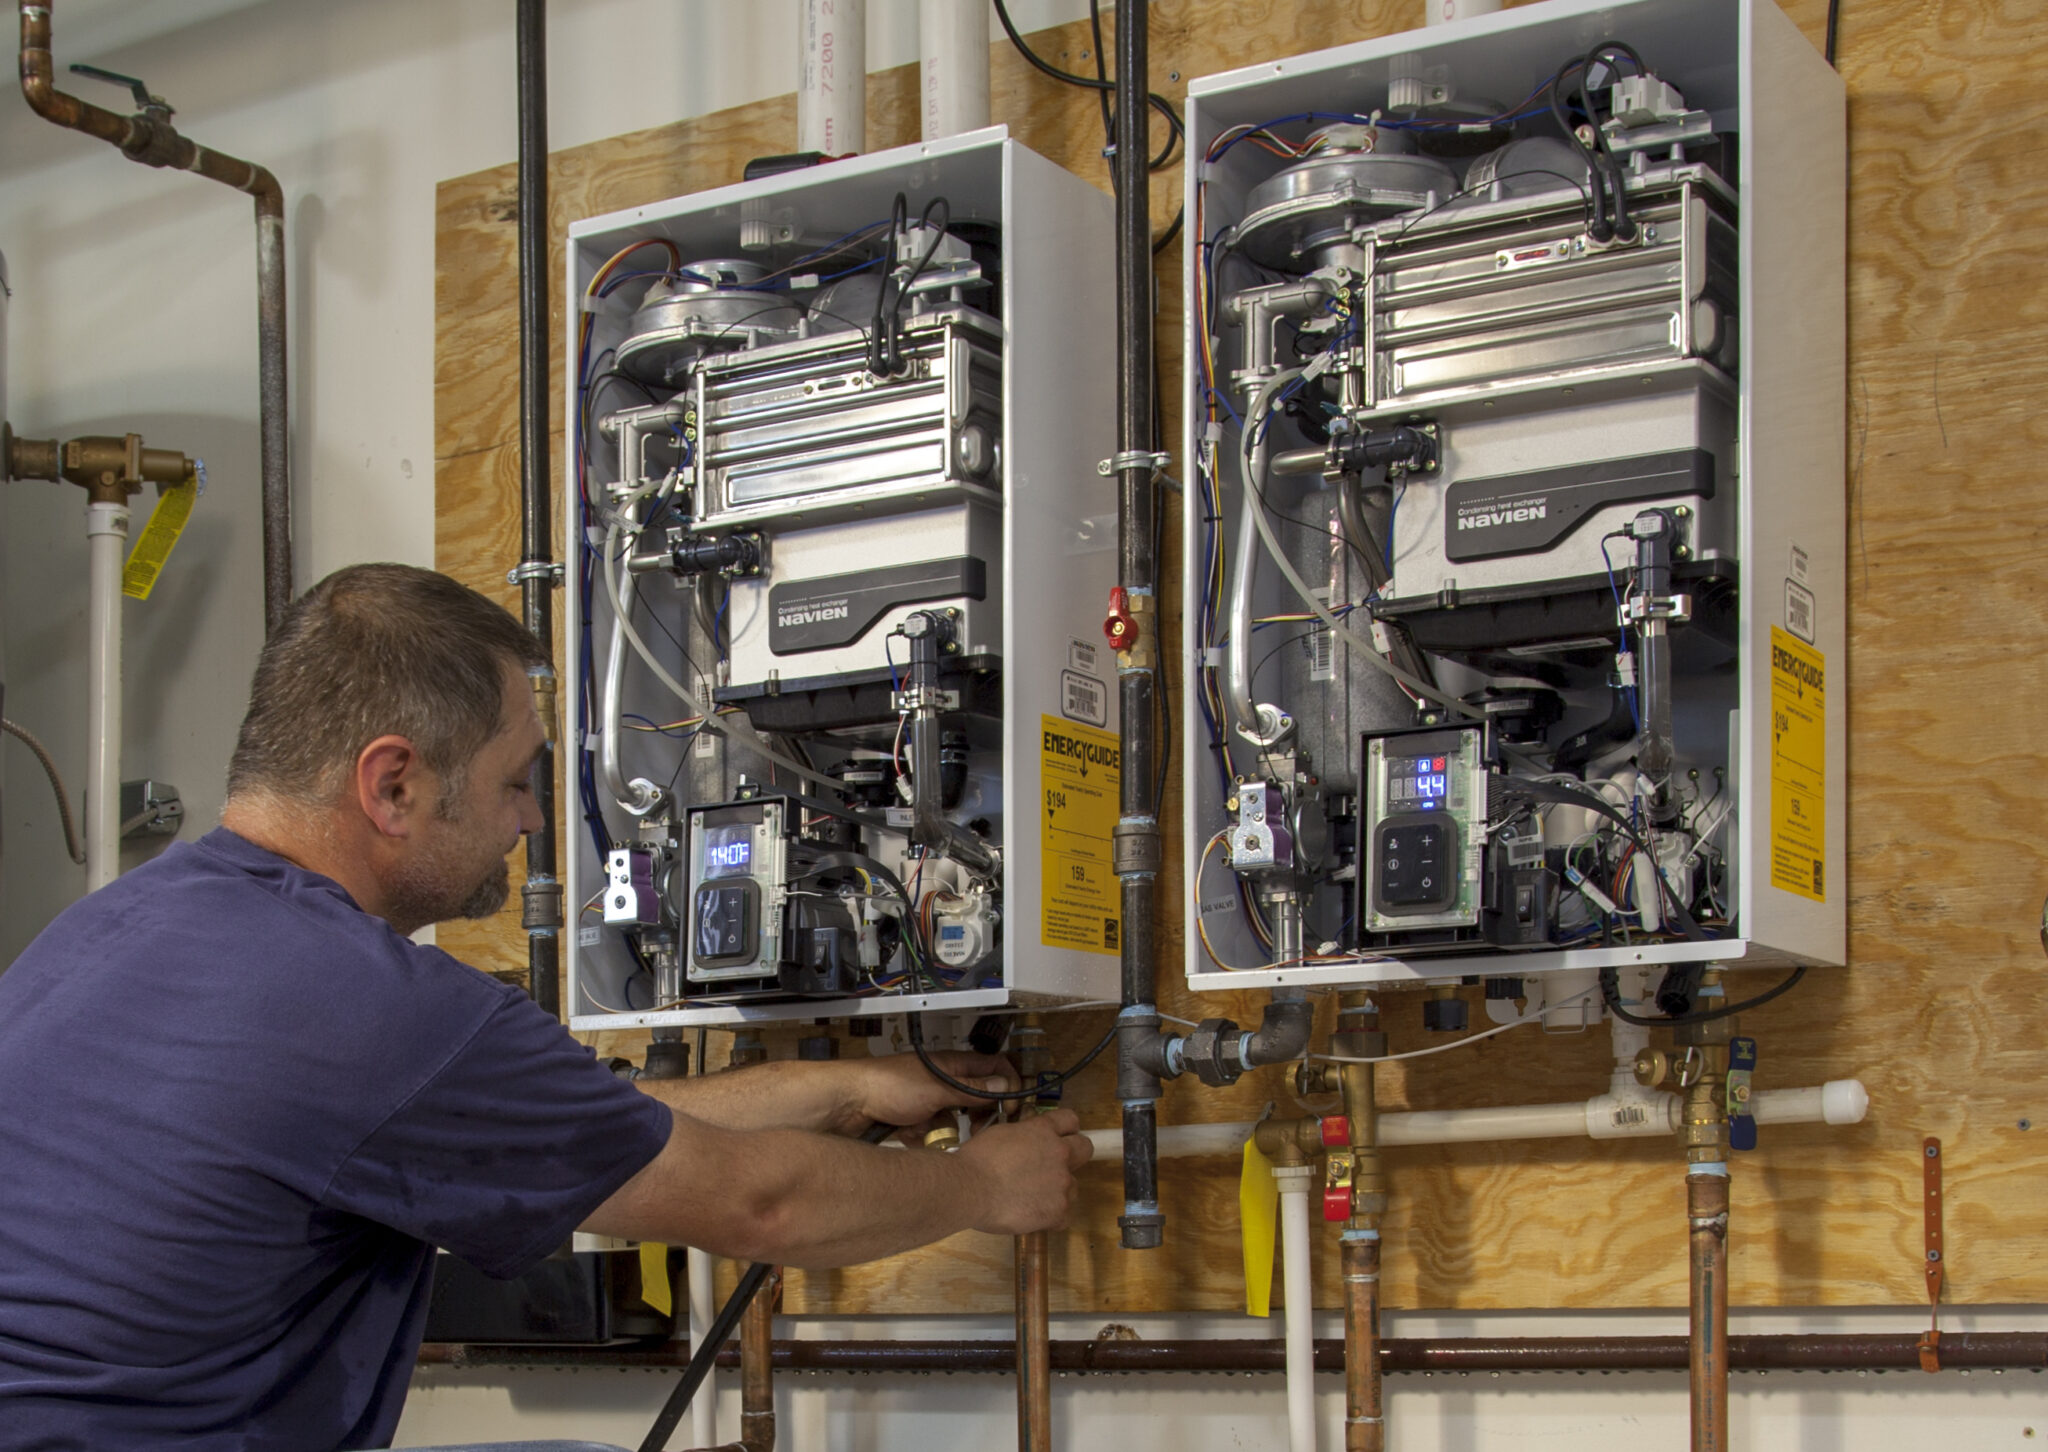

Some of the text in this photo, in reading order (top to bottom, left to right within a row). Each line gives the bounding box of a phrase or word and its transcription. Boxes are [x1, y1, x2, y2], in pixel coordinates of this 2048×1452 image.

[821, 32, 834, 97] 7200
[1417, 774, 1446, 798] 4.4
[1046, 789, 1066, 809] $194
[1071, 865, 1085, 881] 159
